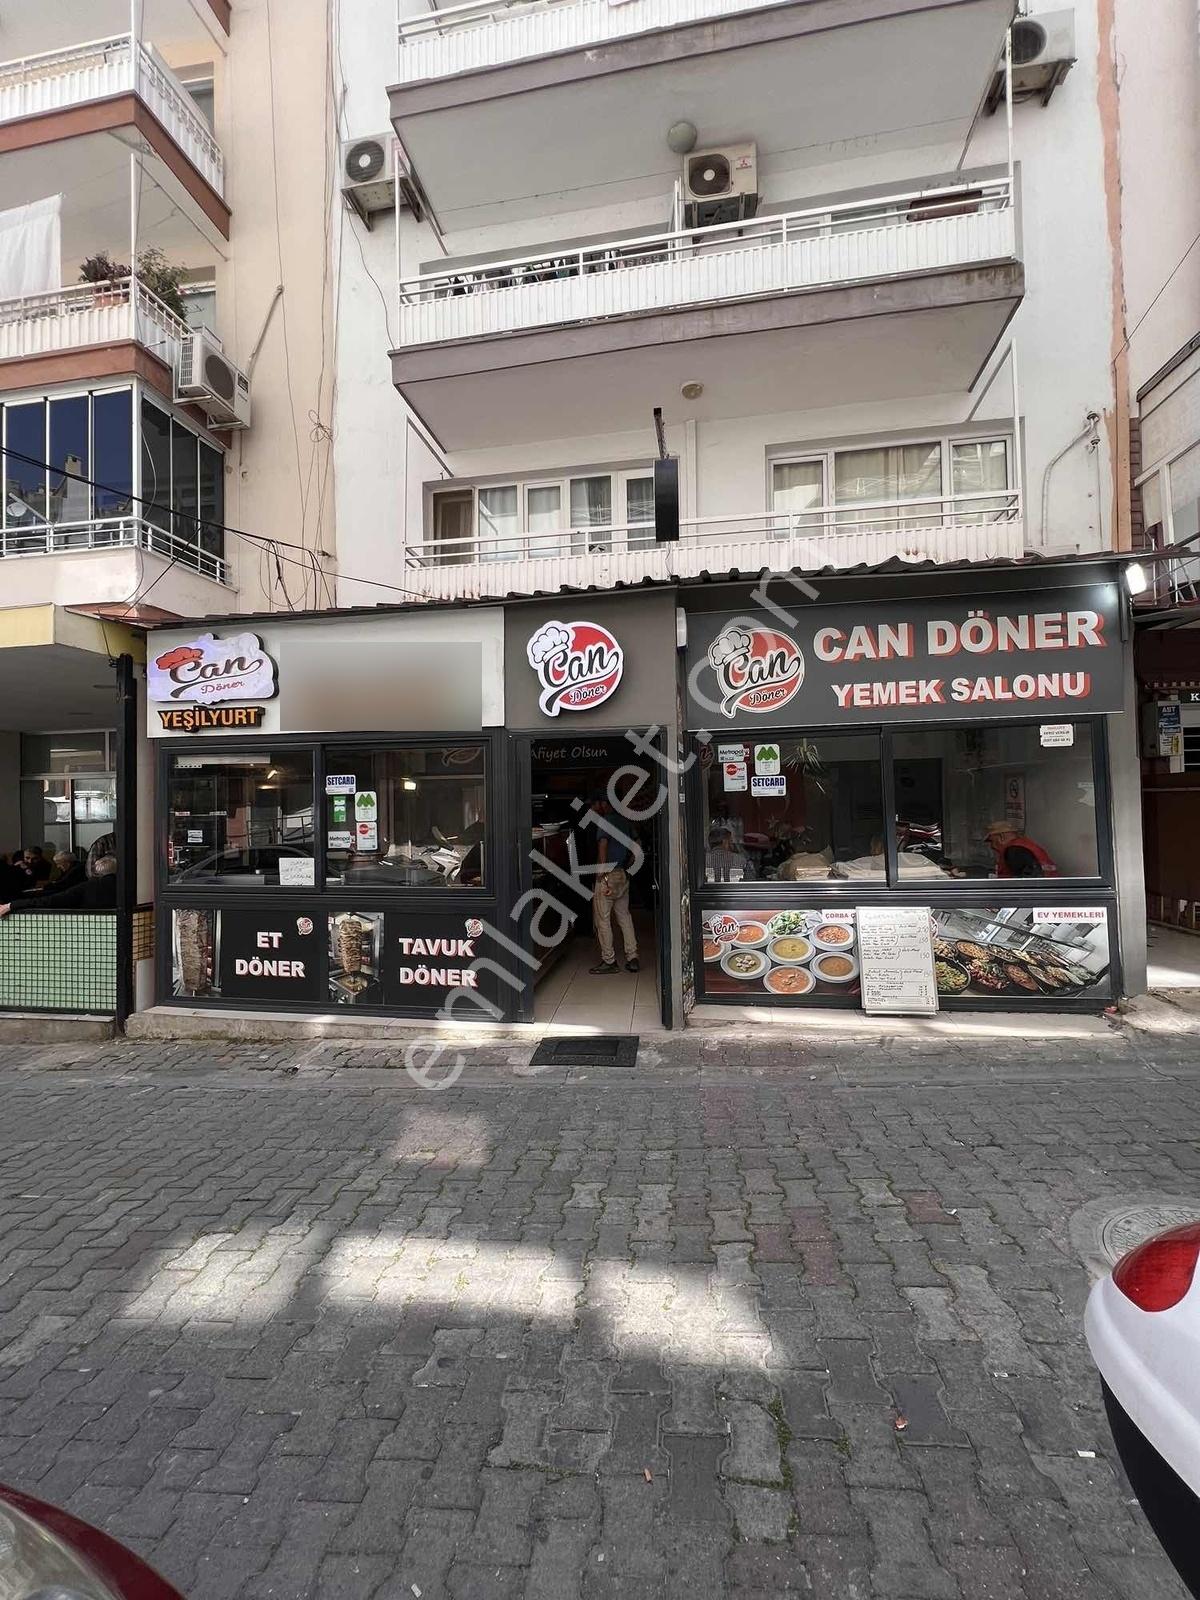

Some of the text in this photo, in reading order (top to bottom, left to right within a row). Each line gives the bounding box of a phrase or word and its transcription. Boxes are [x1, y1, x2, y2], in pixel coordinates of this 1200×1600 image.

[813, 610, 1106, 664] CAN DÖNER
[170, 654, 264, 686] Can
[543, 644, 619, 684] Can
[723, 649, 801, 690] Can
[200, 680, 245, 694] Döner
[569, 685, 606, 704] Döner
[750, 688, 787, 705] Döner
[831, 671, 1089, 708] YEMEK SALONU
[160, 707, 260, 731] YEŞİLYURT
[571, 746, 608, 759] Olsun
[328, 777, 355, 785] SETCARD
[752, 777, 785, 787] SETCARD
[257, 931, 282, 948] ET
[399, 937, 476, 958] TAVUK
[235, 956, 306, 978] DÖNER
[399, 964, 478, 987] DÖNER
